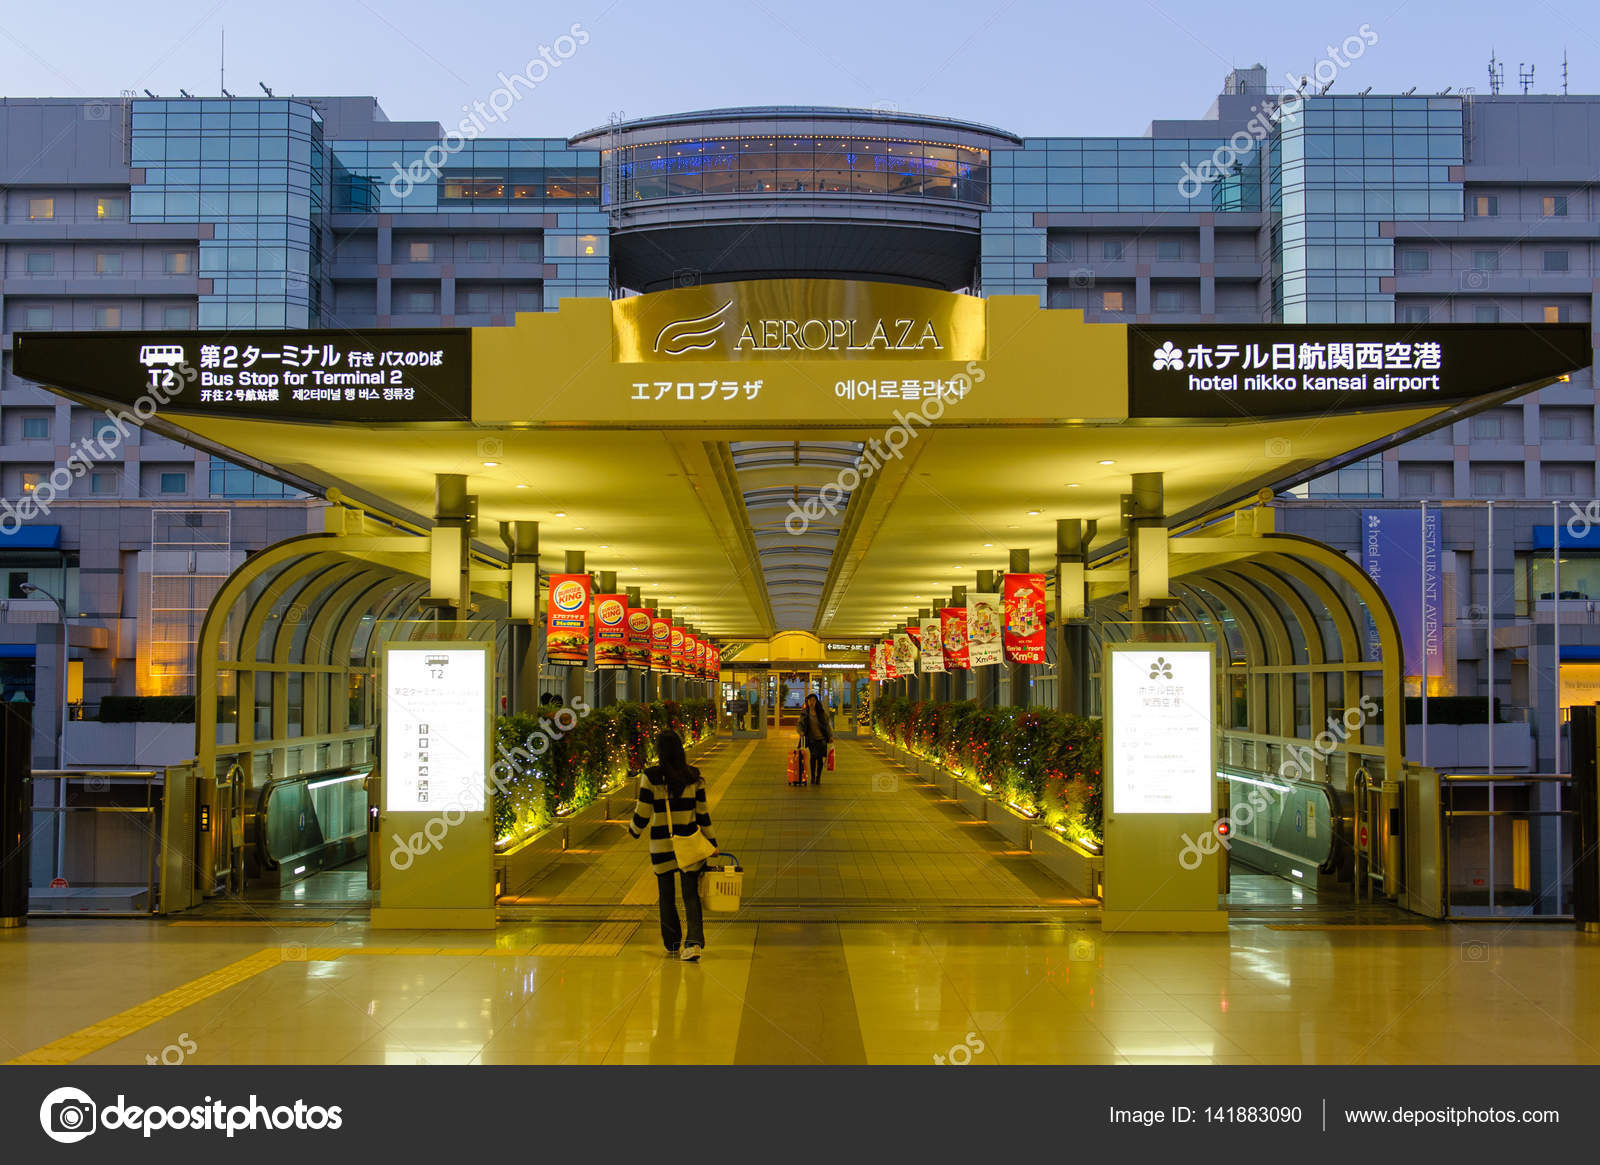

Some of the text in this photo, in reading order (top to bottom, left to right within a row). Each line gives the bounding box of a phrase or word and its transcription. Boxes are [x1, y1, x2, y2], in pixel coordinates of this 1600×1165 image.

[733, 319, 944, 350] AEROPLAZA
[200, 345, 443, 368] 第2ターミナル 行き バスのりば
[1187, 342, 1441, 370] ホテル日航関西空港
[148, 369, 175, 387] T2
[201, 370, 403, 388] Bus Stop for Terminal 2
[1188, 374, 1440, 392] hotel nikko kansai airport
[292, 388, 415, 401] 제2터미널 행 버스 정류장
[631, 379, 763, 401] エアロプラザ
[834, 379, 966, 401] 에어로플라자
[1368, 530, 1381, 585] hotel nikk
[1425, 515, 1437, 601] RESTAURANT
[558, 591, 582, 604] KING
[1425, 604, 1438, 656] AVENUE
[430, 669, 444, 679] T2
